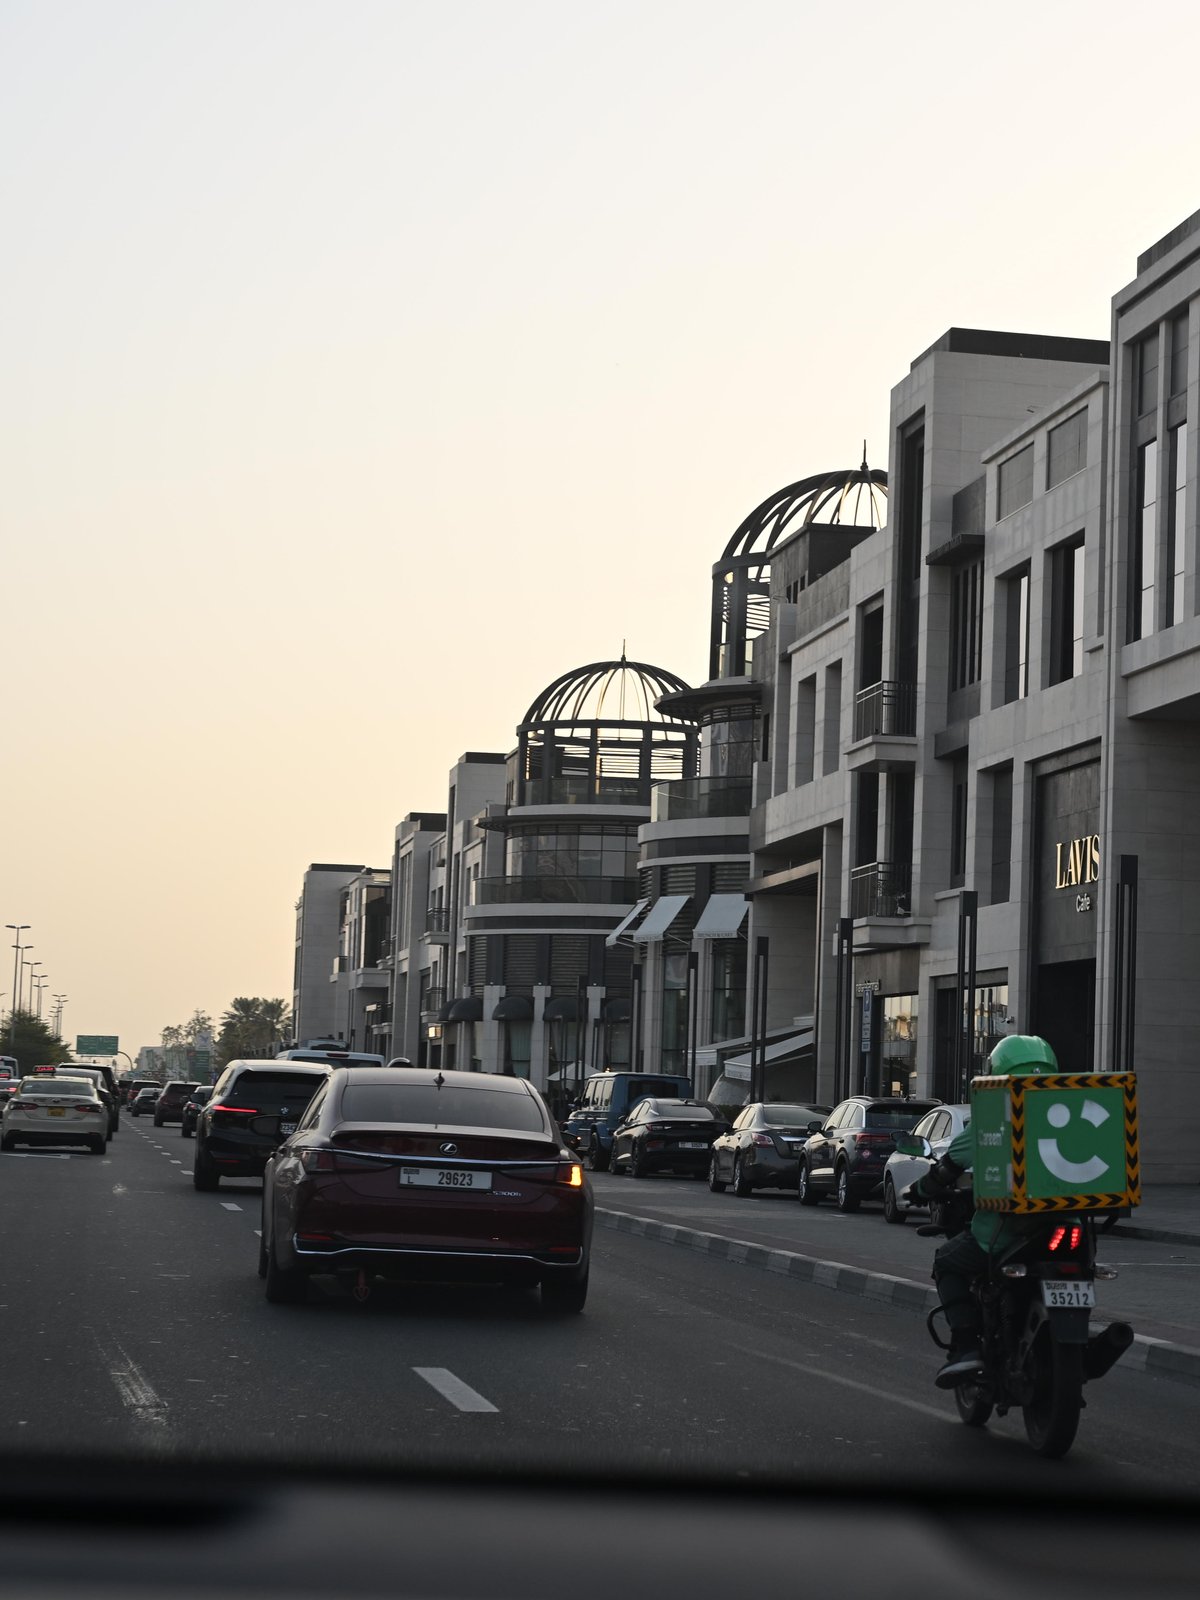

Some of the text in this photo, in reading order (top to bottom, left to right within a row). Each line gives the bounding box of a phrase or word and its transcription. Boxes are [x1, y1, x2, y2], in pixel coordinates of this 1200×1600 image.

[1076, 893, 1091, 912] Cafe
[407, 1175, 414, 1184] L
[438, 1171, 473, 1187] 29623
[1051, 1292, 1089, 1306] 35212
